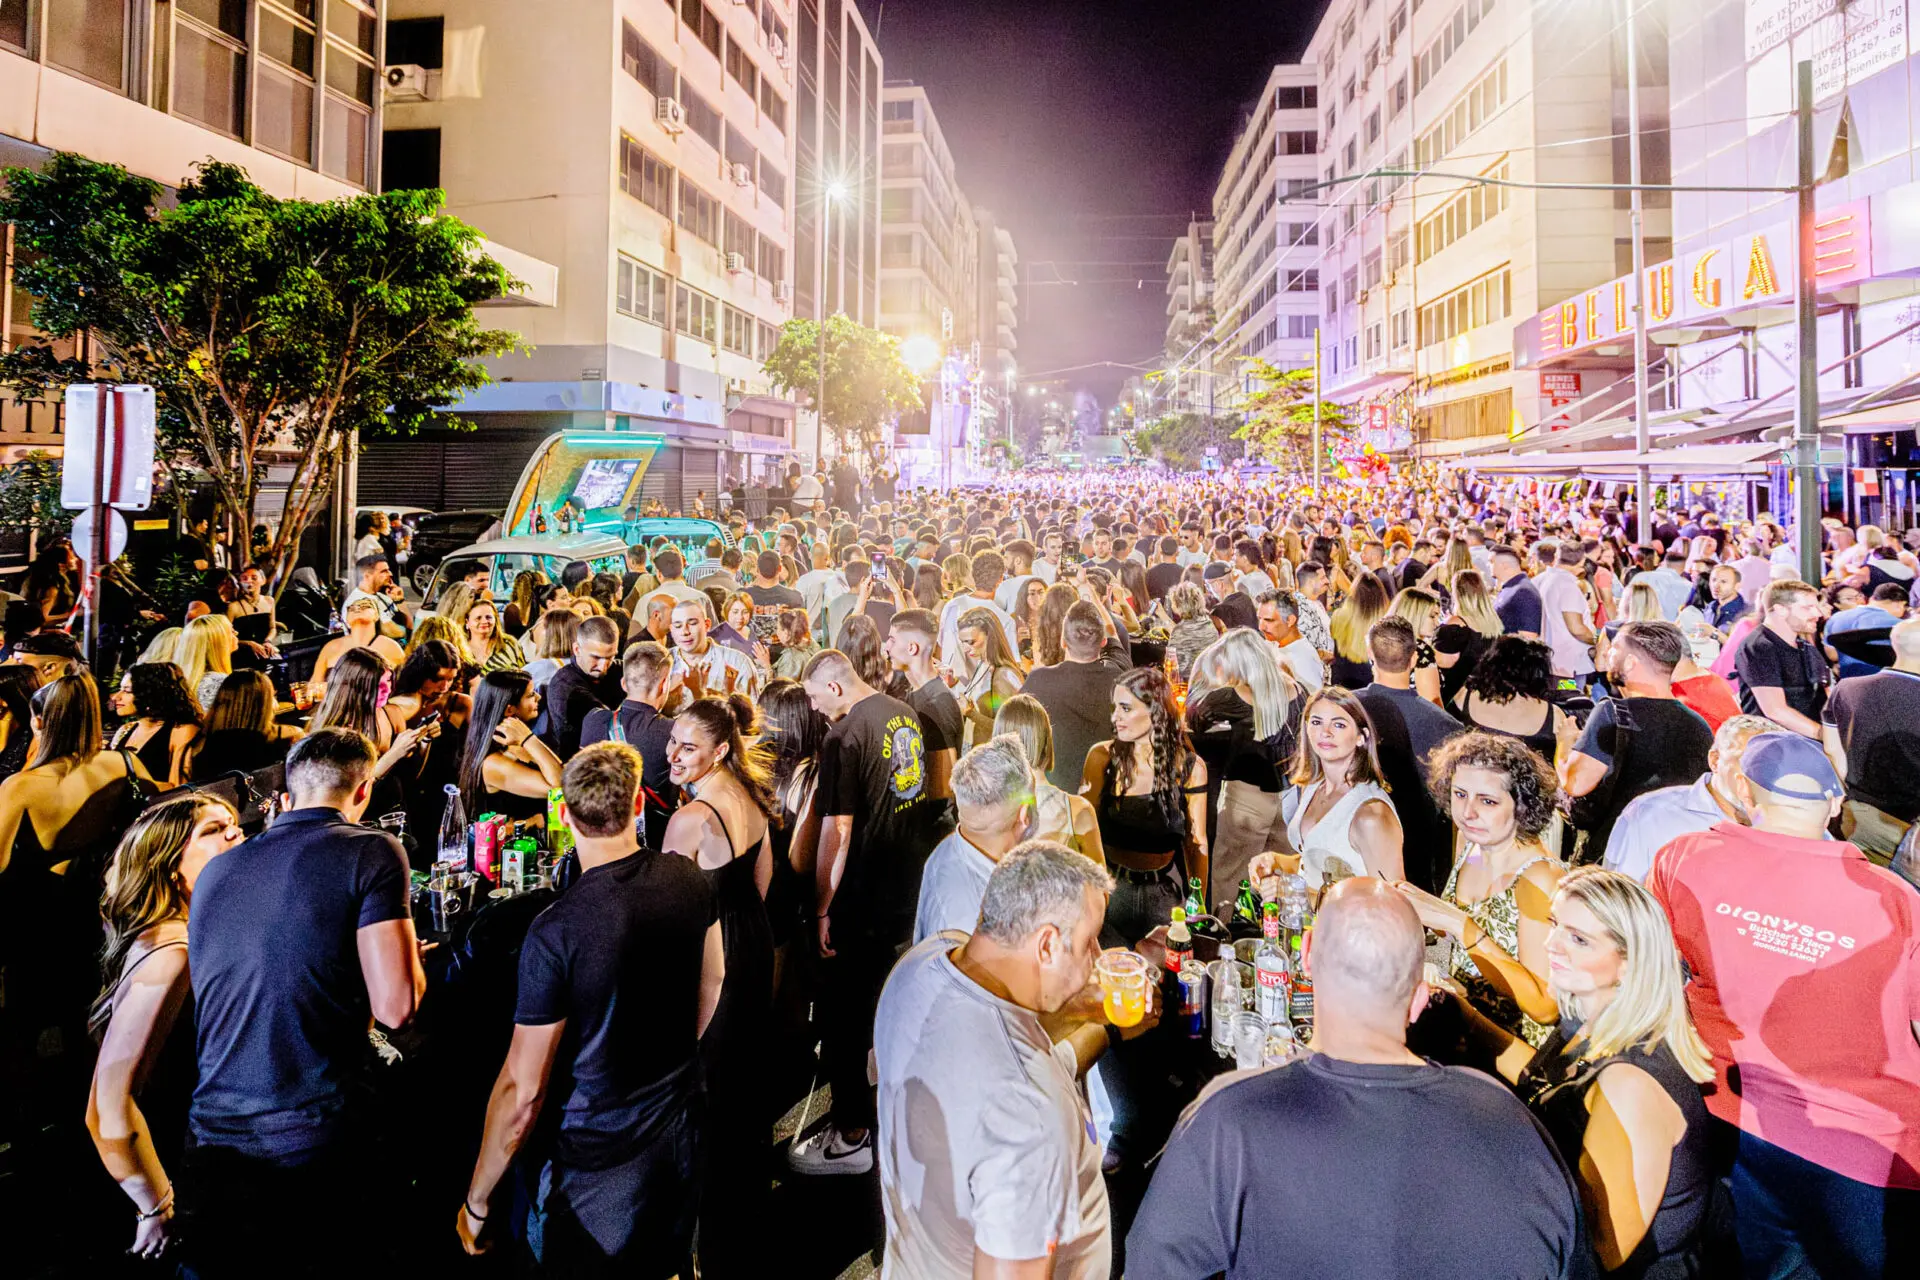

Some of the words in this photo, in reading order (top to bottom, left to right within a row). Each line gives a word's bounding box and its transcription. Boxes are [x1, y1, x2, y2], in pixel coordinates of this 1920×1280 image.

[1889, 5, 1903, 21] 70
[1889, 23, 1903, 38] 68
[1561, 234, 1781, 350] BELUGA
[886, 715, 903, 733] THE
[882, 732, 893, 759] OFF
[1715, 902, 1856, 949] DIONYSOS
[1749, 923, 1799, 942] Butcher's
[1801, 937, 1832, 952] Place
[1753, 932, 1788, 947] 22730
